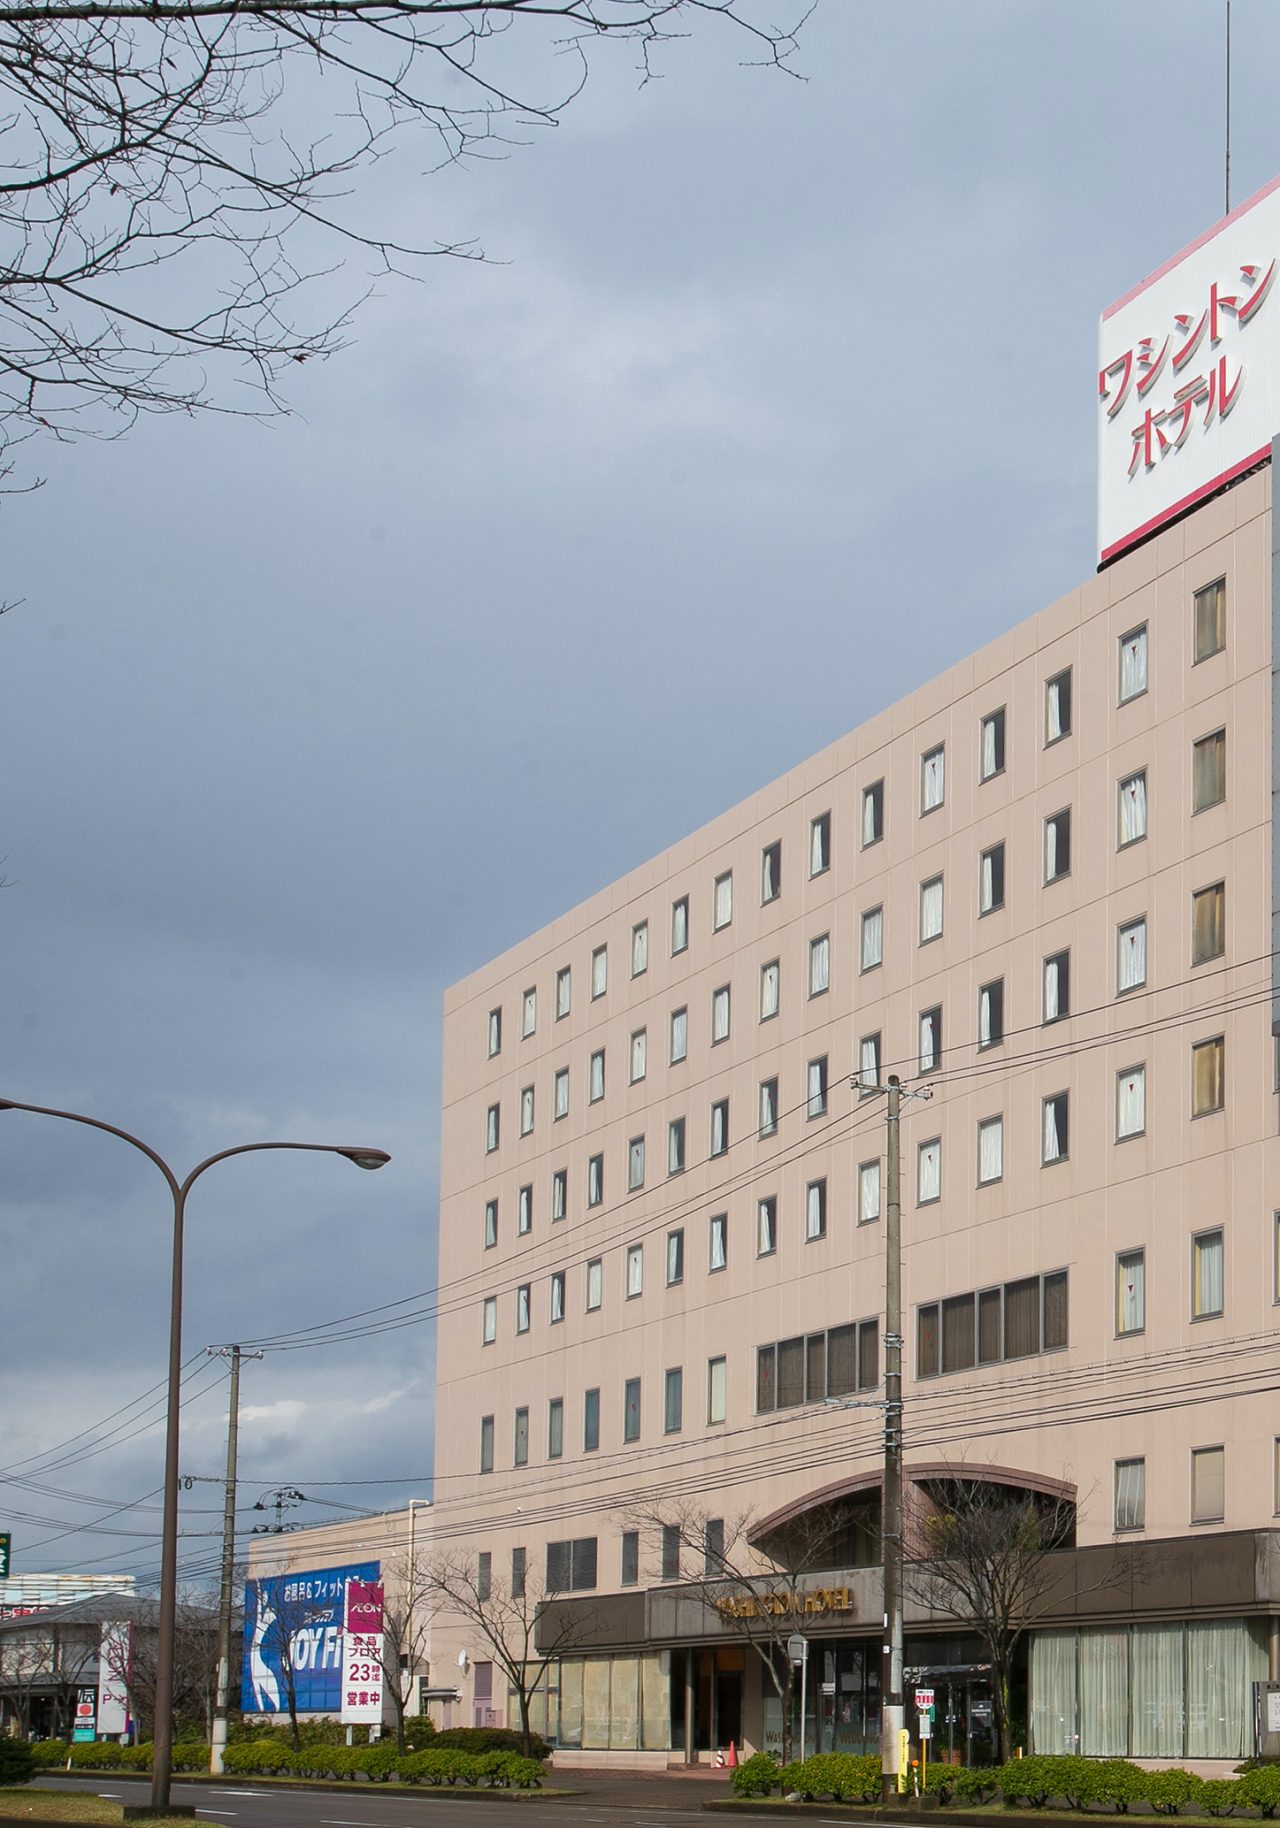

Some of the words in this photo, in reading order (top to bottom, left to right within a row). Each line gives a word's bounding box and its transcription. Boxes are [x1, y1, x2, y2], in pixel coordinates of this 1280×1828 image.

[1098, 256, 1279, 418] ワシントン
[1127, 354, 1248, 477] ホテル
[283, 1576, 361, 1602] お風呂&フィット
[352, 1636, 377, 1646] 食品
[347, 1691, 380, 1706] 営業中
